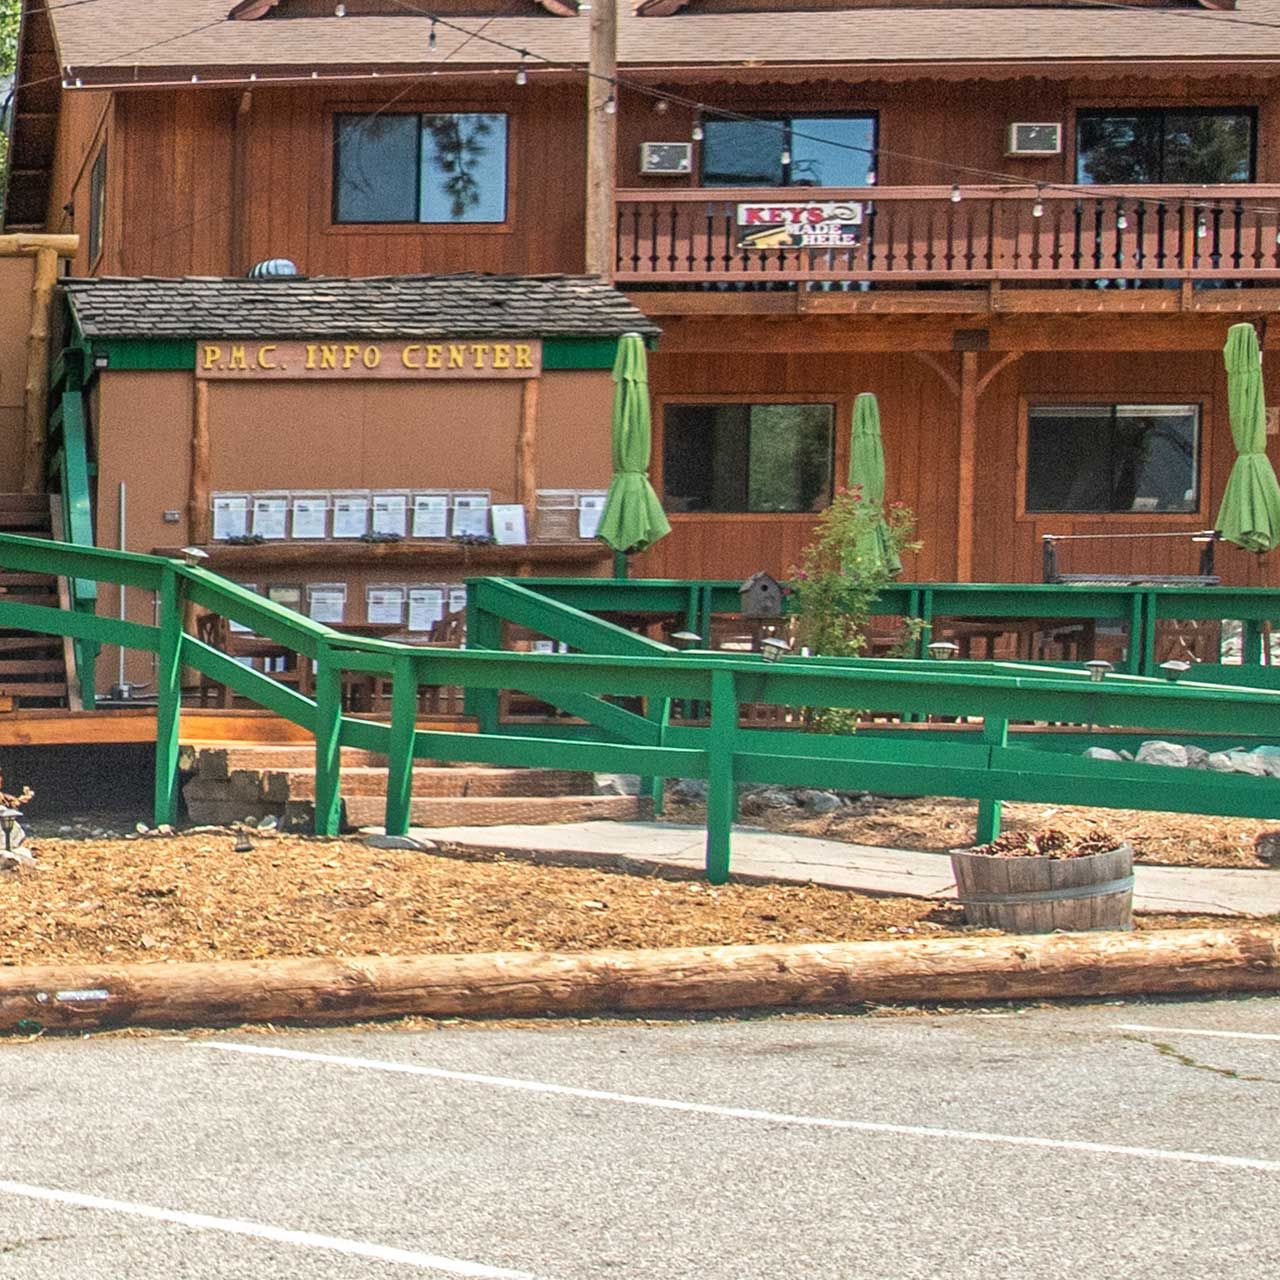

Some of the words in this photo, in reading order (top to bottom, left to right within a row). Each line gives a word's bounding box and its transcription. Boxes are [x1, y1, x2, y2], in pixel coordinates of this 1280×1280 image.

[744, 207, 825, 224] KEYS
[784, 223, 842, 235] MADE
[801, 234, 856, 246] HERE
[305, 344, 382, 370] INFO
[401, 343, 534, 370] CENTER
